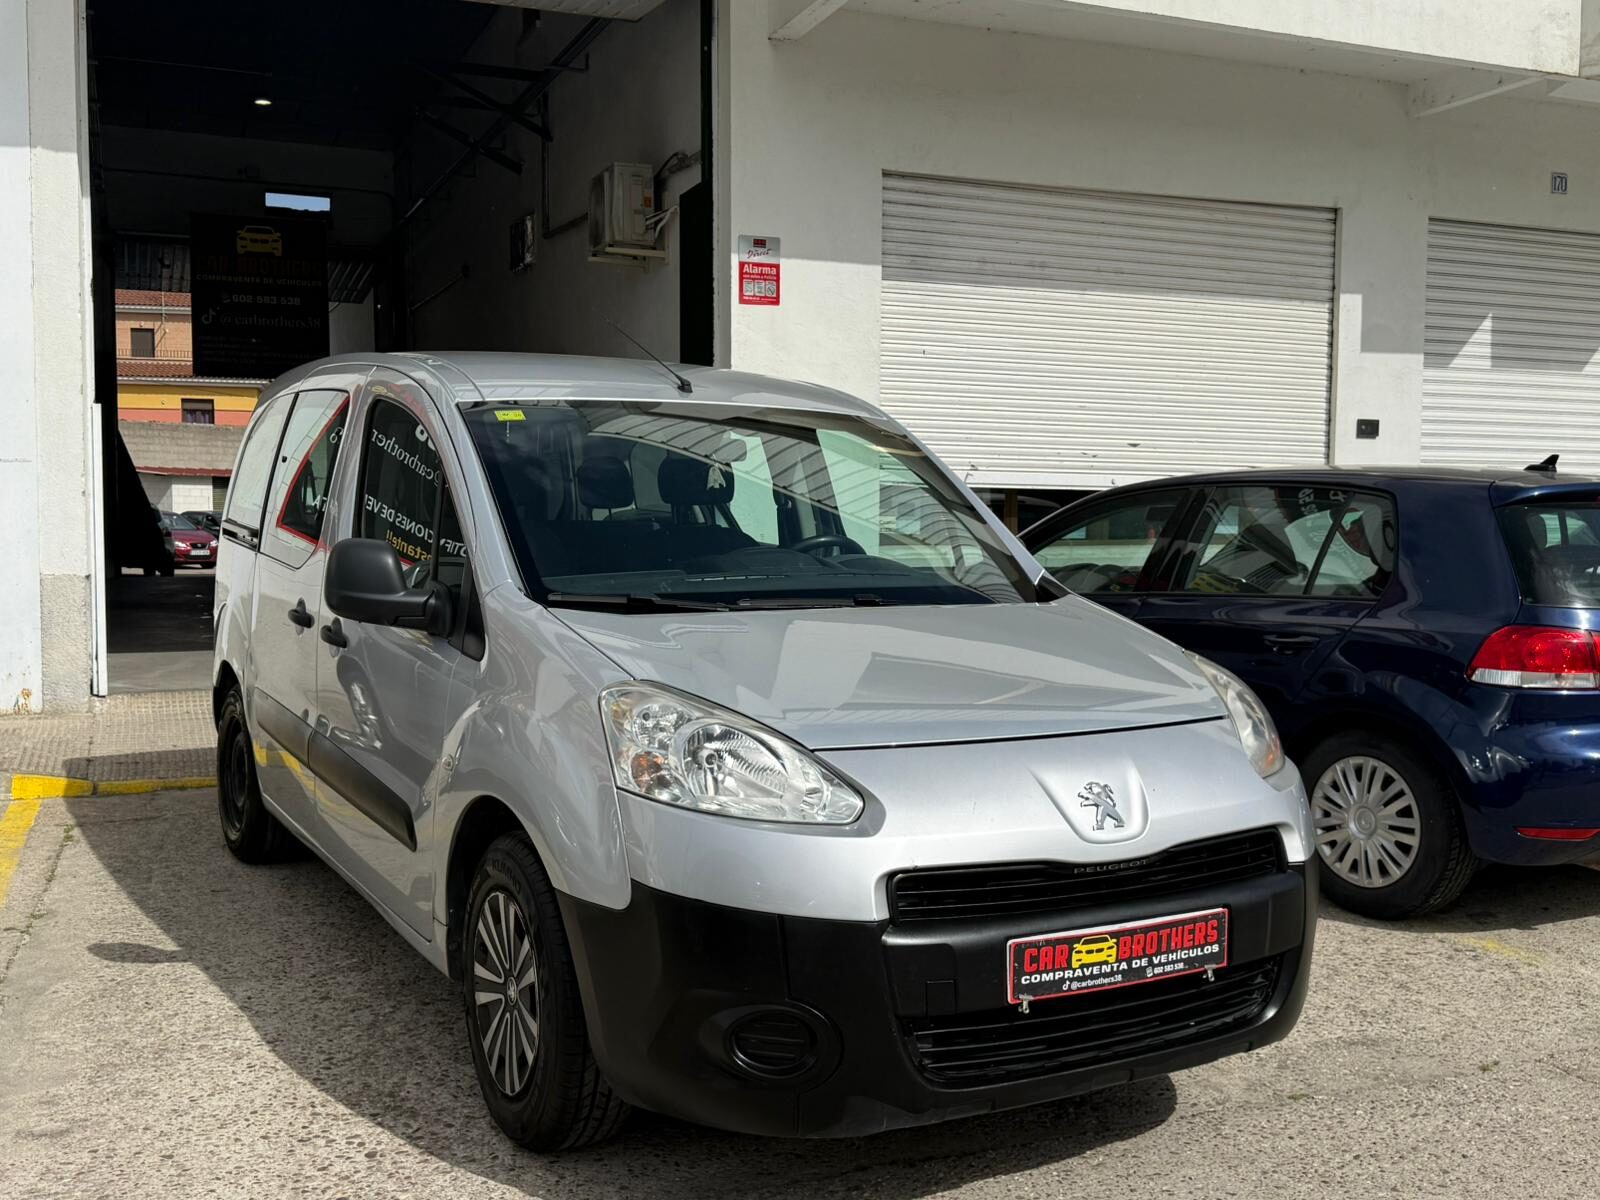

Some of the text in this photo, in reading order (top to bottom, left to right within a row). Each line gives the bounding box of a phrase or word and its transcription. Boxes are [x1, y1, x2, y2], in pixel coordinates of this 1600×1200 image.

[1553, 175, 1568, 192] 170
[743, 263, 777, 275] Alarma
[1073, 857, 1149, 874] PEUGEOT
[1023, 919, 1219, 974] CAR BROTHERS
[1020, 943, 1220, 985] COMPRAVENTA DE VEHÍCULOS
[1070, 974, 1123, 990] @carbrothers38
